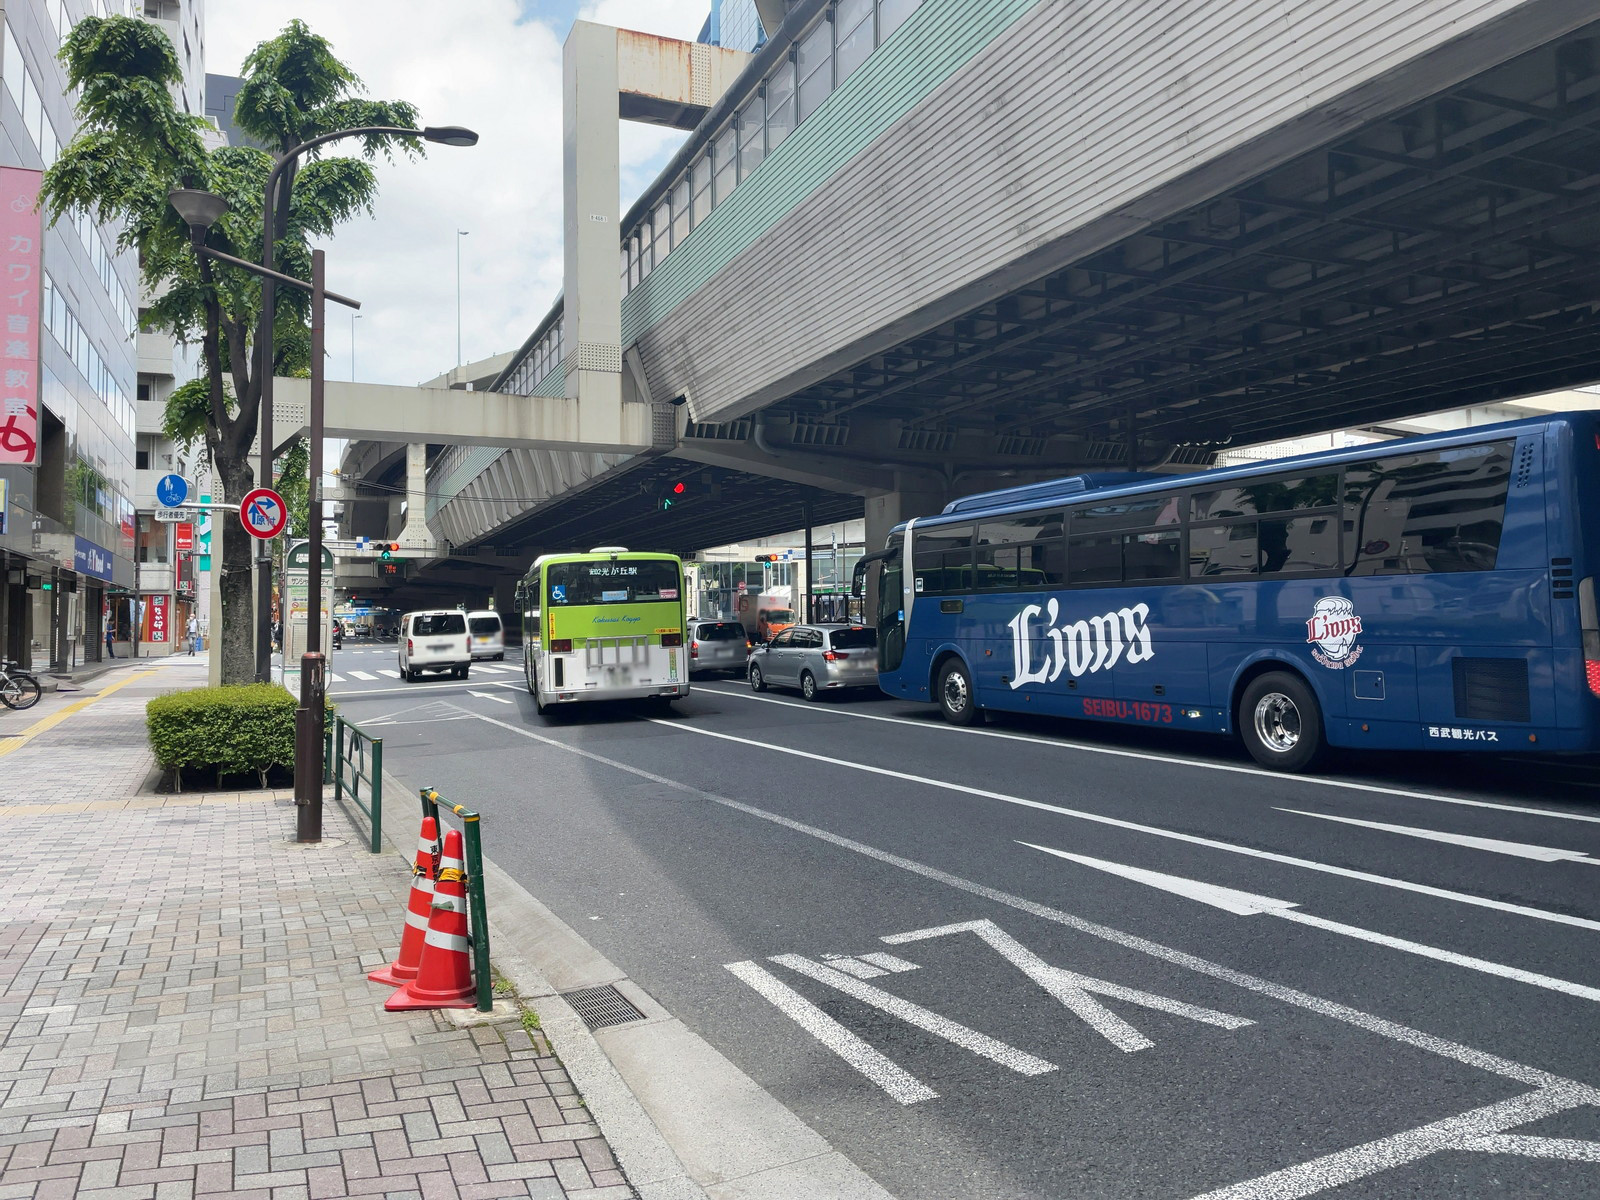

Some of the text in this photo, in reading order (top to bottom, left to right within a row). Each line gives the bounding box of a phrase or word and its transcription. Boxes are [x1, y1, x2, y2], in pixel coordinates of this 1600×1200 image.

[5, 235, 32, 416] カワイ音楽教室
[157, 511, 185, 519] 歩行者優先
[153, 606, 164, 630] なか卯
[1083, 697, 1173, 724] SEIBU-1673
[1428, 726, 1499, 741] 西武観光バス
[722, 918, 1258, 1106] バス
